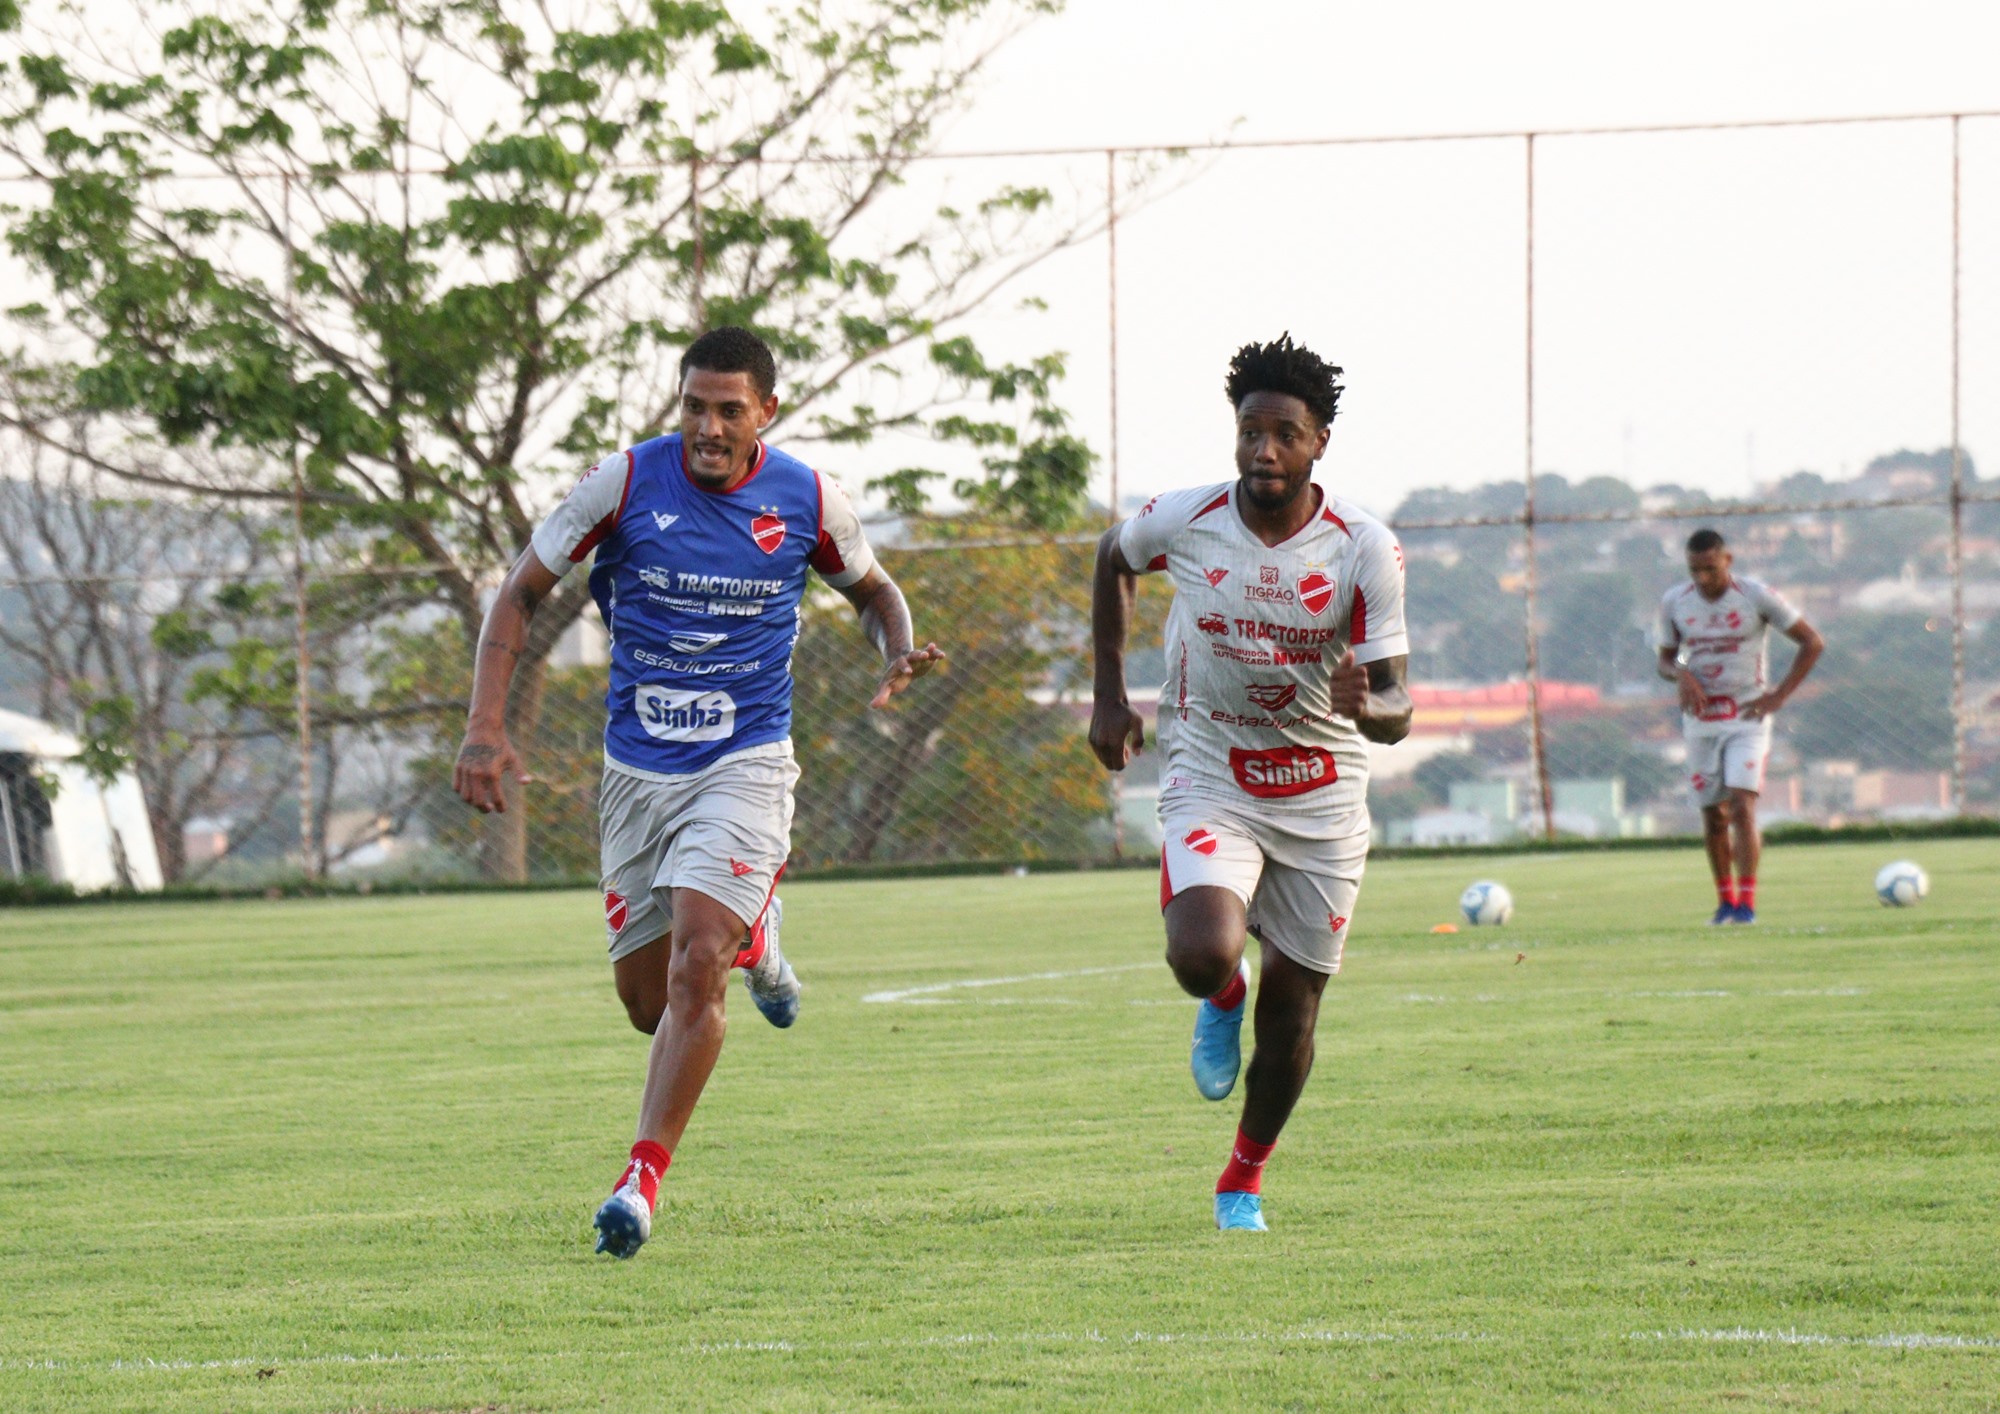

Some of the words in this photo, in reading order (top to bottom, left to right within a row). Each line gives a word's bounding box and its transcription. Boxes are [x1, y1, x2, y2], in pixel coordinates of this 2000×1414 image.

[648, 591, 705, 607] DISTRIBUIDOR
[1244, 585, 1294, 601] TIGRÃO
[1211, 642, 1269, 658] DISTRIBUIDOR
[1213, 650, 1271, 666] AUTORIZADO
[646, 695, 723, 729] Sinhá
[1244, 750, 1325, 786] Sinhá
